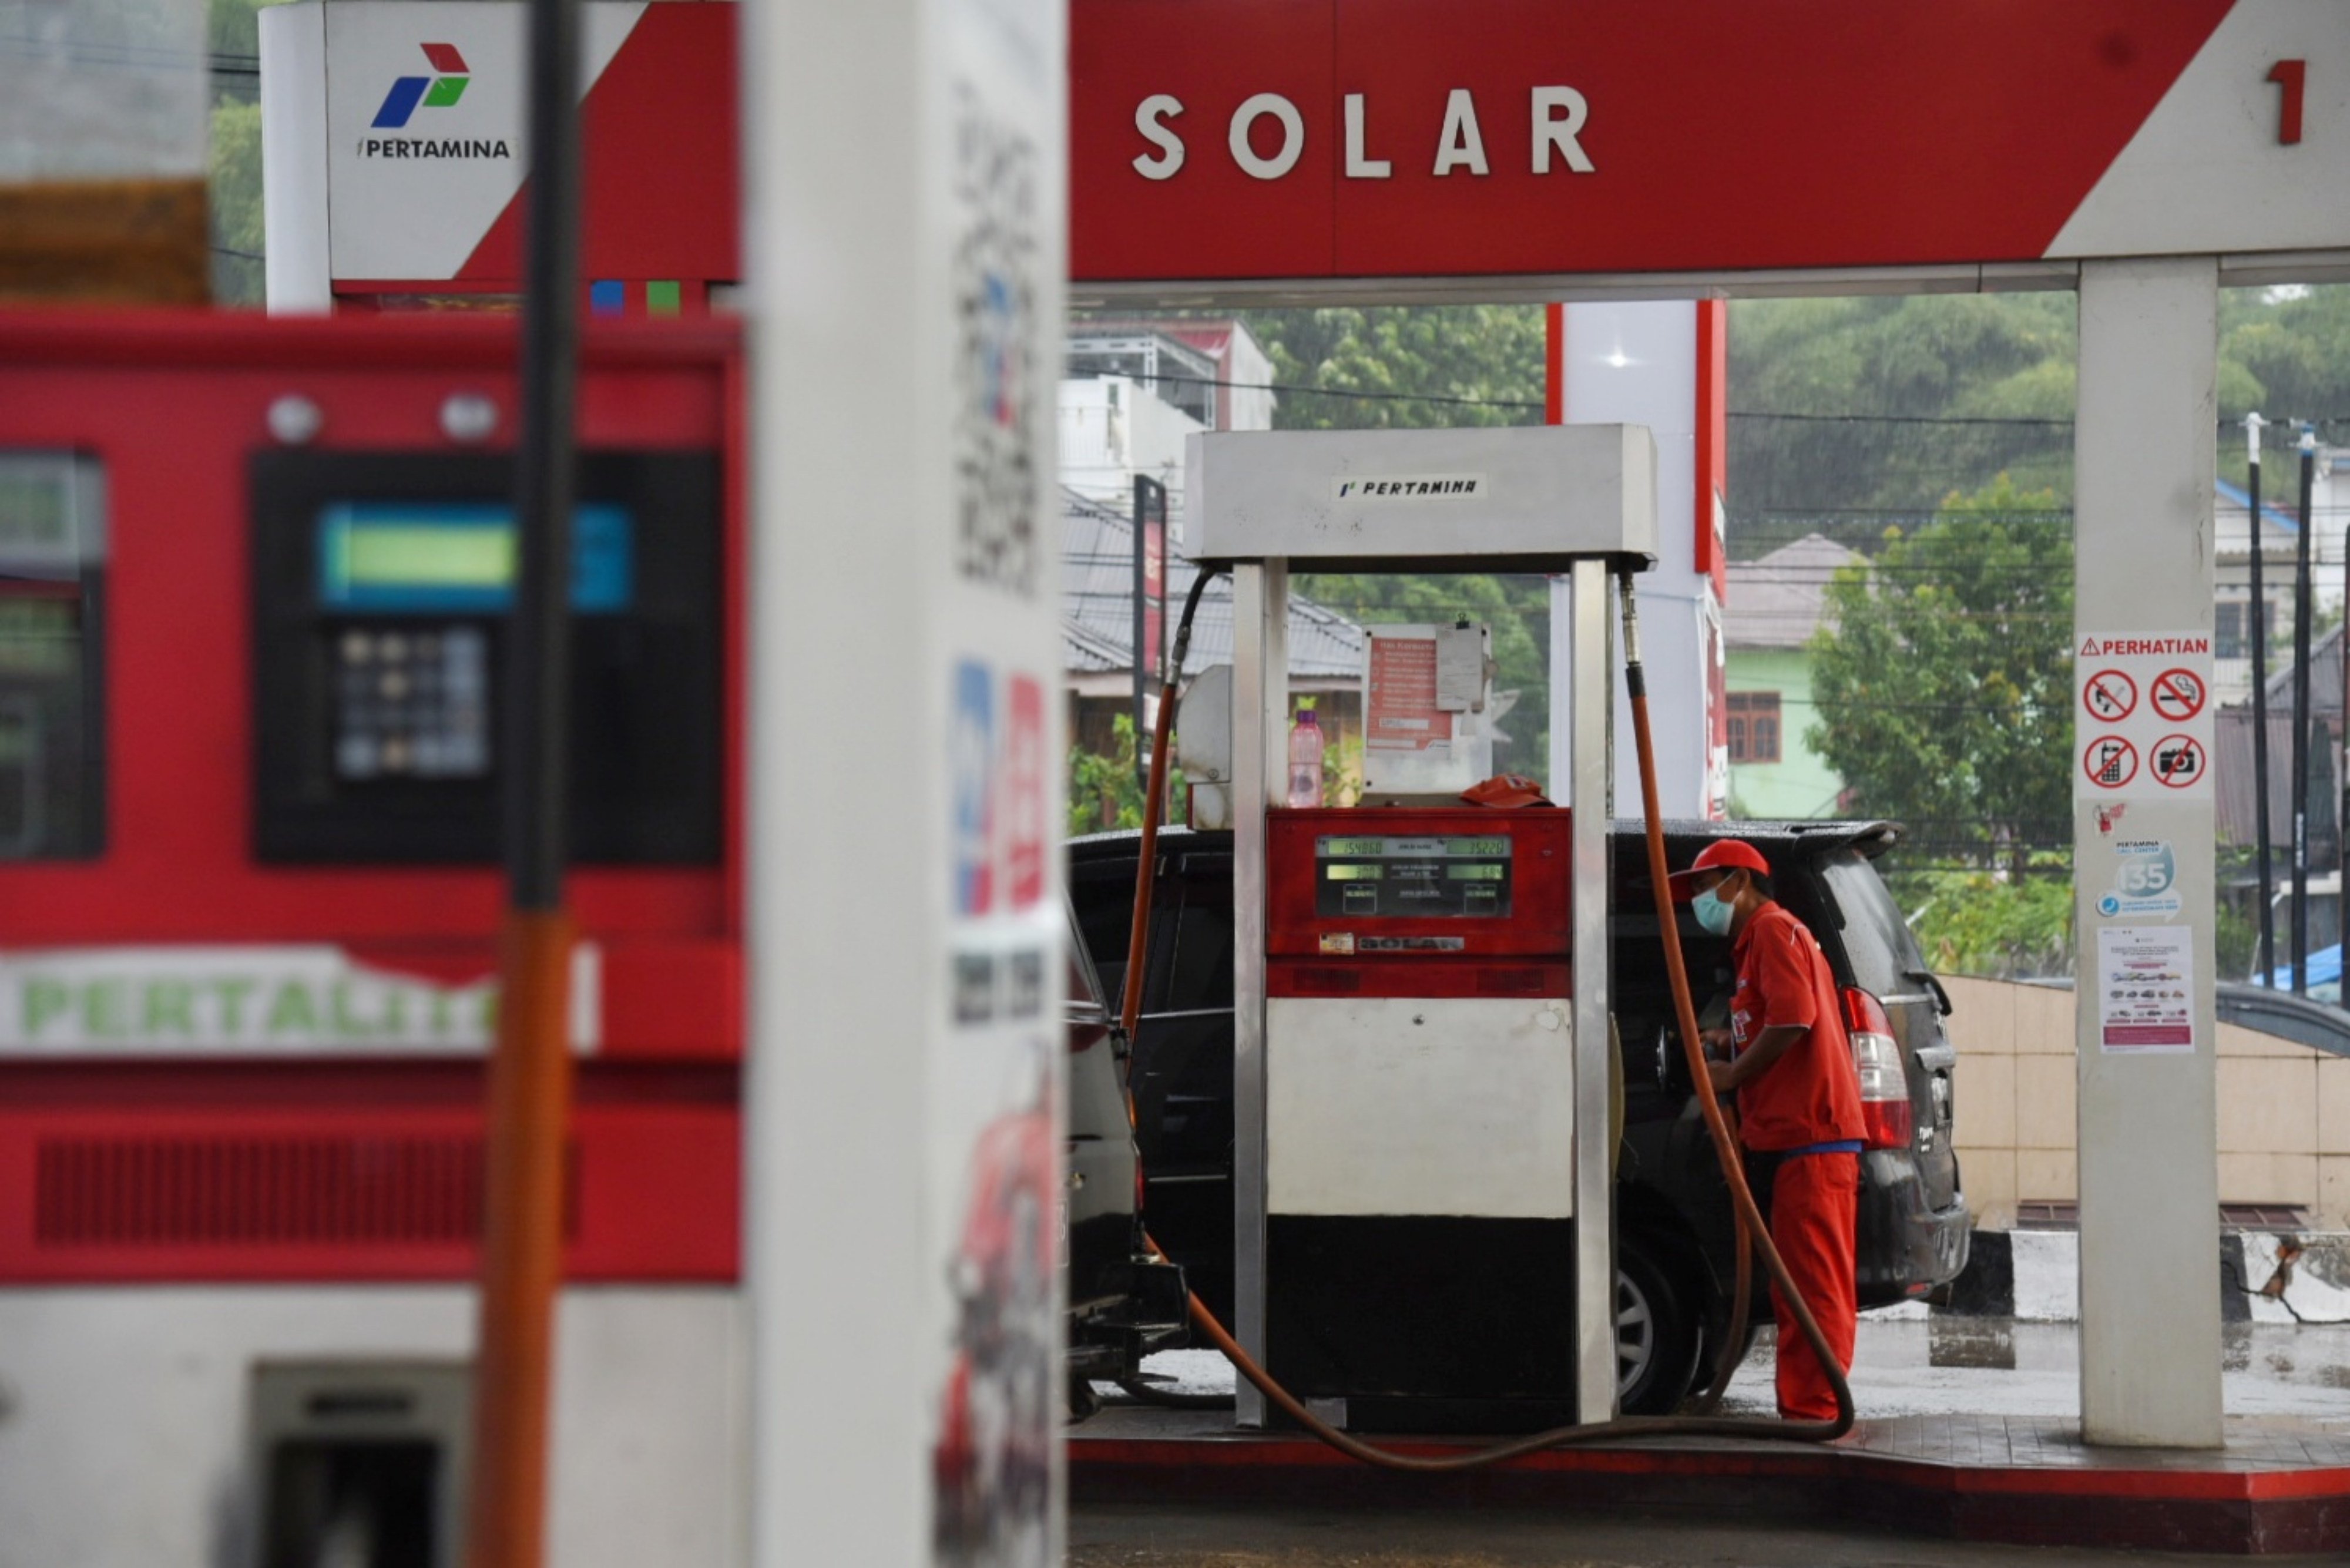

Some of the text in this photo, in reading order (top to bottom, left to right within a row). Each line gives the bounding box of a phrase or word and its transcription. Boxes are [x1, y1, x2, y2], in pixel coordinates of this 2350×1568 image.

[2265, 59, 2305, 145] 1
[1132, 85, 1596, 180] SOLAR
[367, 139, 510, 158] PERTAMINA
[1362, 480, 1477, 495] PERTAMINA
[2103, 639, 2209, 655] PERHATIAN
